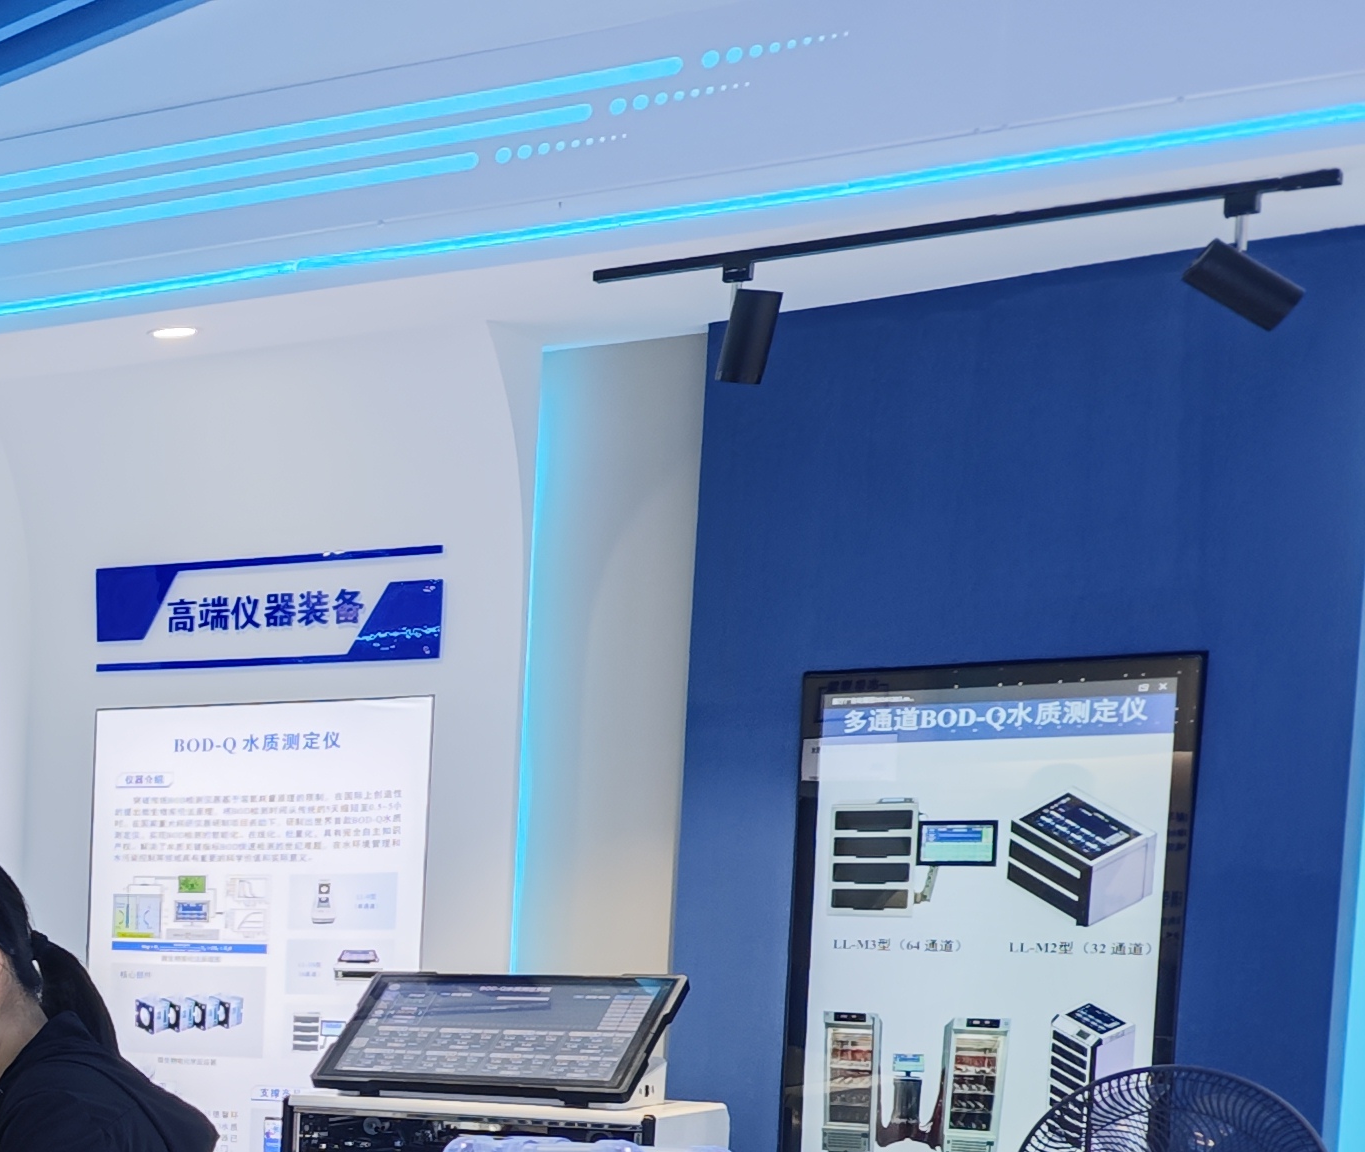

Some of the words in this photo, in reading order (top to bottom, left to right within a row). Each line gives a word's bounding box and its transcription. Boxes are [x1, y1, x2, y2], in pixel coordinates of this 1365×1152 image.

[167, 588, 365, 633] 高端仪器装备
[844, 697, 1148, 734] 多通道BOD-Q水质测定仪
[173, 737, 237, 755] BOD-Q
[242, 731, 341, 752] 水质测定仪
